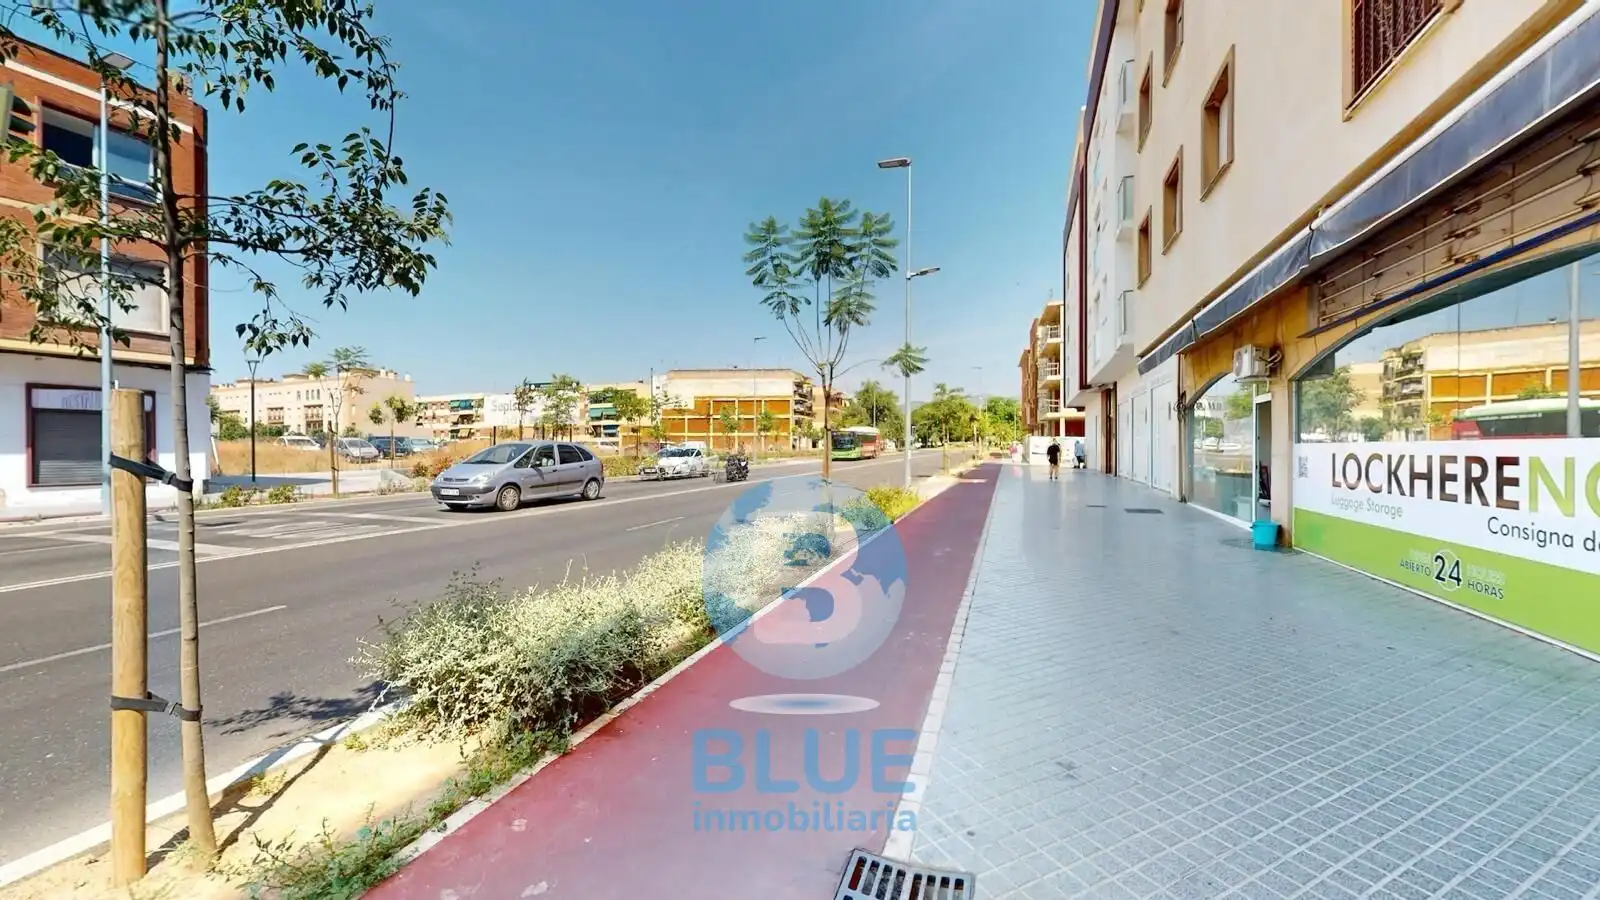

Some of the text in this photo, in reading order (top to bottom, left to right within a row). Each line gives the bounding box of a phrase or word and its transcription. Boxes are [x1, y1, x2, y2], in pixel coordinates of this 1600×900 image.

[1331, 493, 1403, 519] Luggage Storage
[1487, 516, 1600, 553] Consigna d
[1399, 558, 1432, 577] ABIERTO
[1433, 554, 1463, 587] 24
[1467, 580, 1504, 600] HORAS
